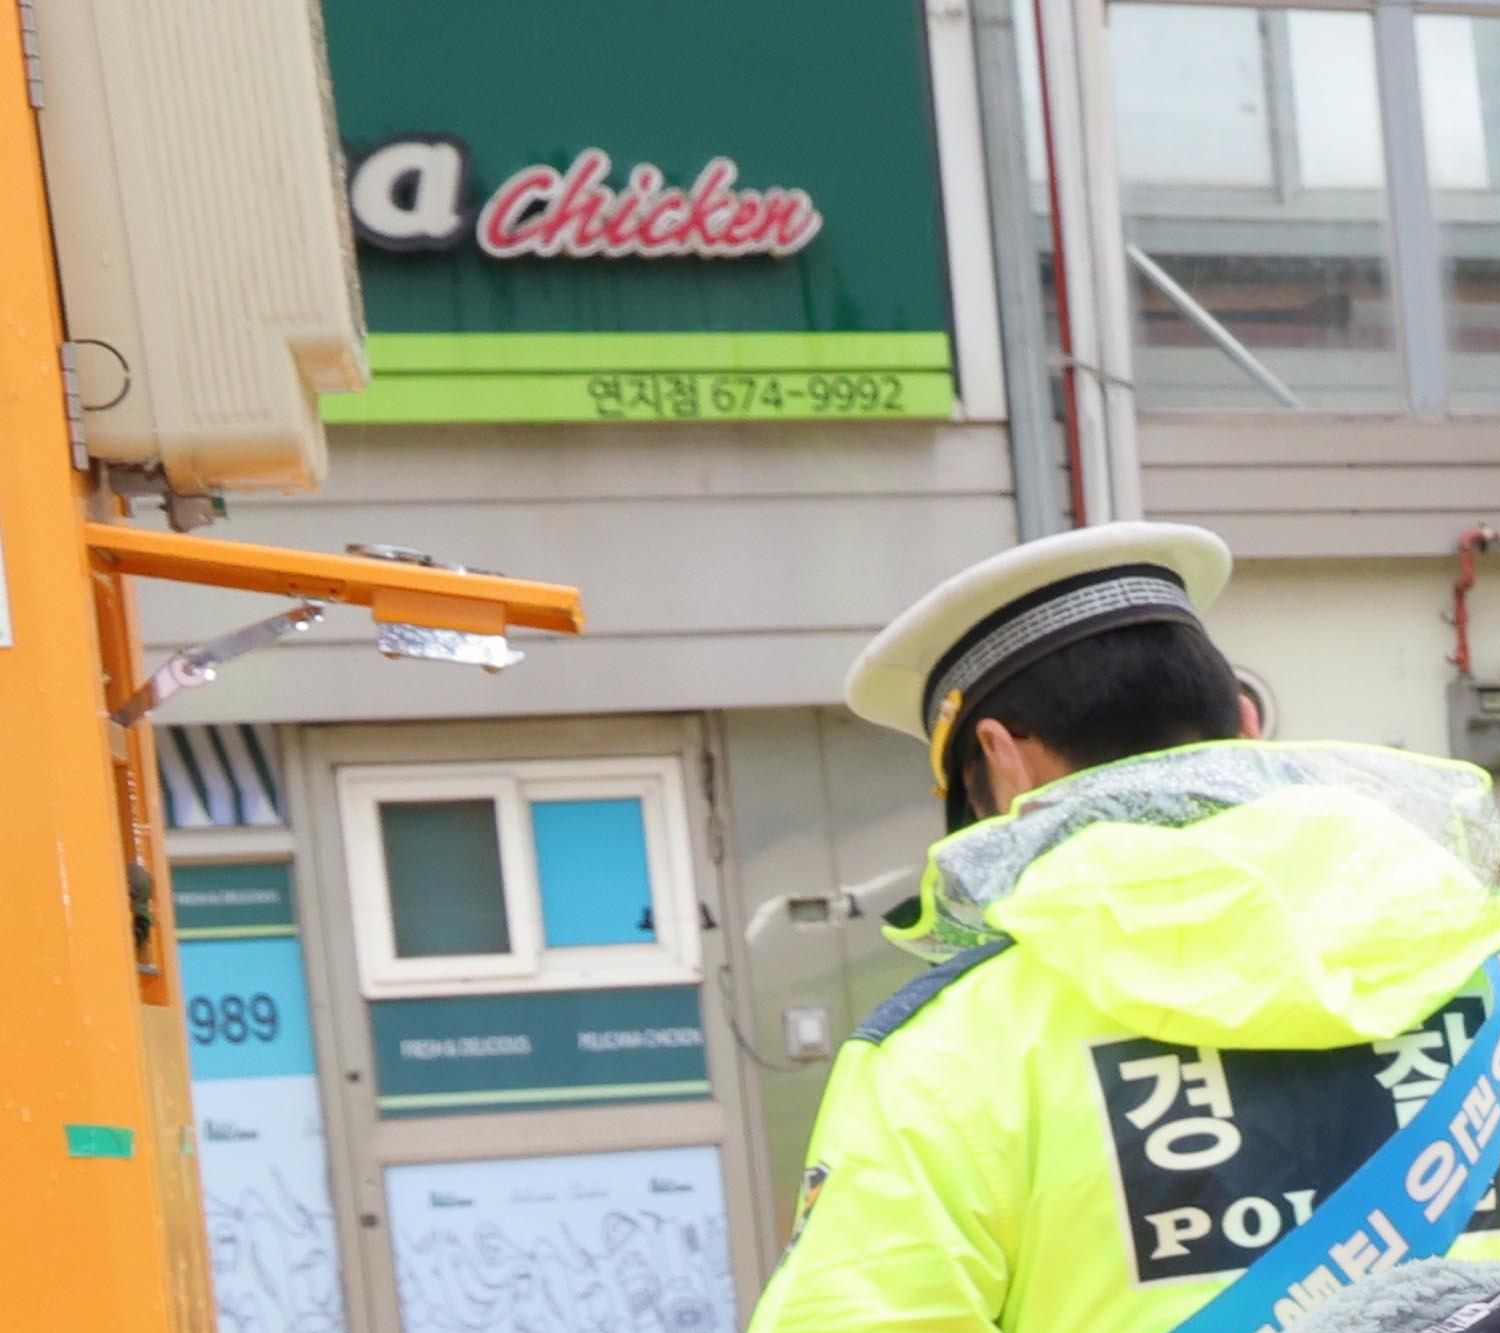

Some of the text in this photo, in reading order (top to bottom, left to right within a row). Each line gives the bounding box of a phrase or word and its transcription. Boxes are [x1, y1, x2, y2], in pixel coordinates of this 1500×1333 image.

[478, 148, 822, 259] Chicken
[587, 373, 904, 418] 연지점 674-9992
